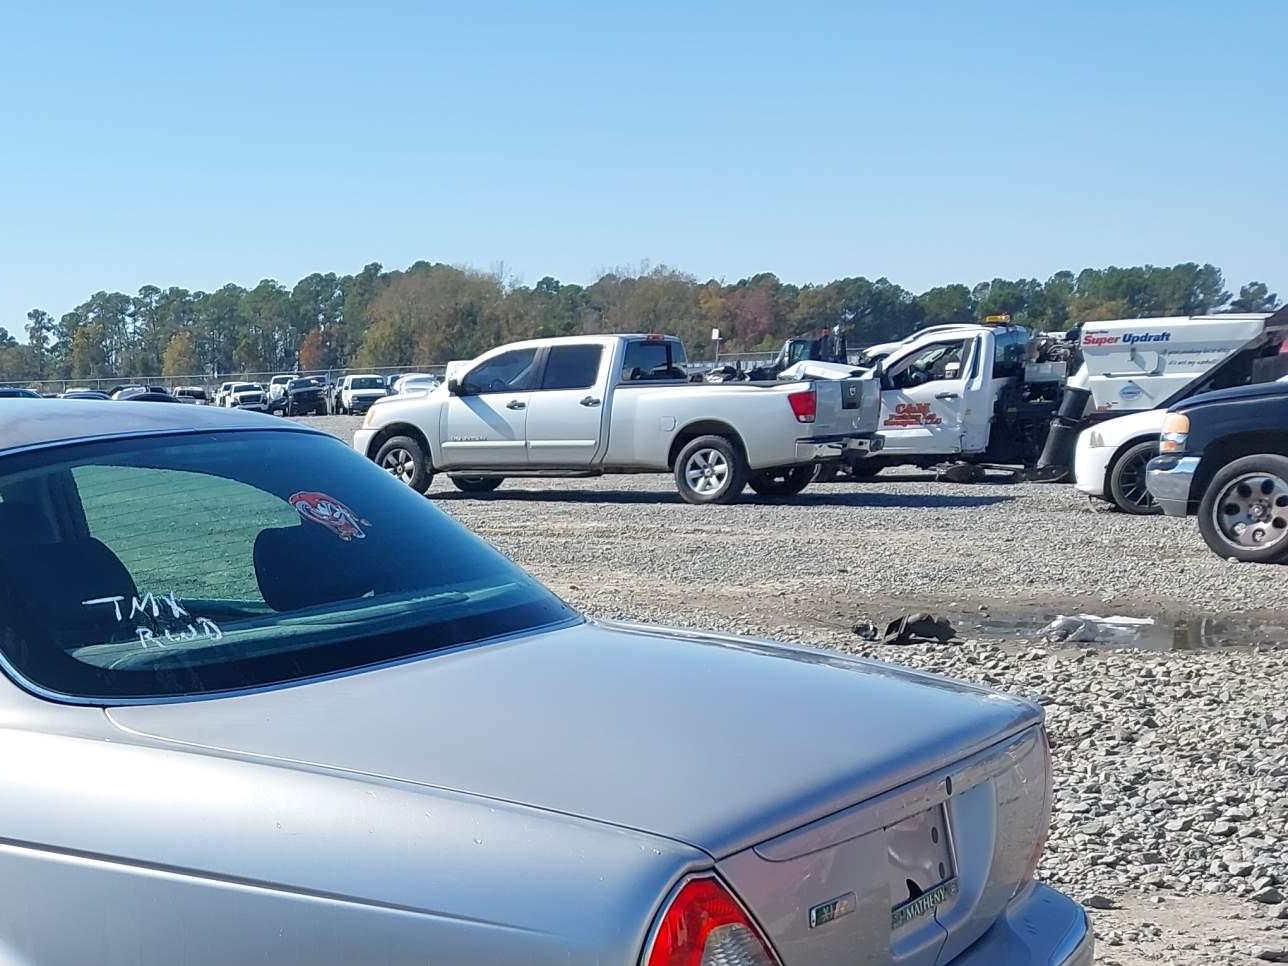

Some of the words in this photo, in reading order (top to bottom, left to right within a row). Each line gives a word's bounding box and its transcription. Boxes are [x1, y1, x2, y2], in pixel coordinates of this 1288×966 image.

[1083, 335, 1120, 346] Super
[1122, 331, 1171, 345] Updraft
[906, 886, 945, 921] MATHENY
